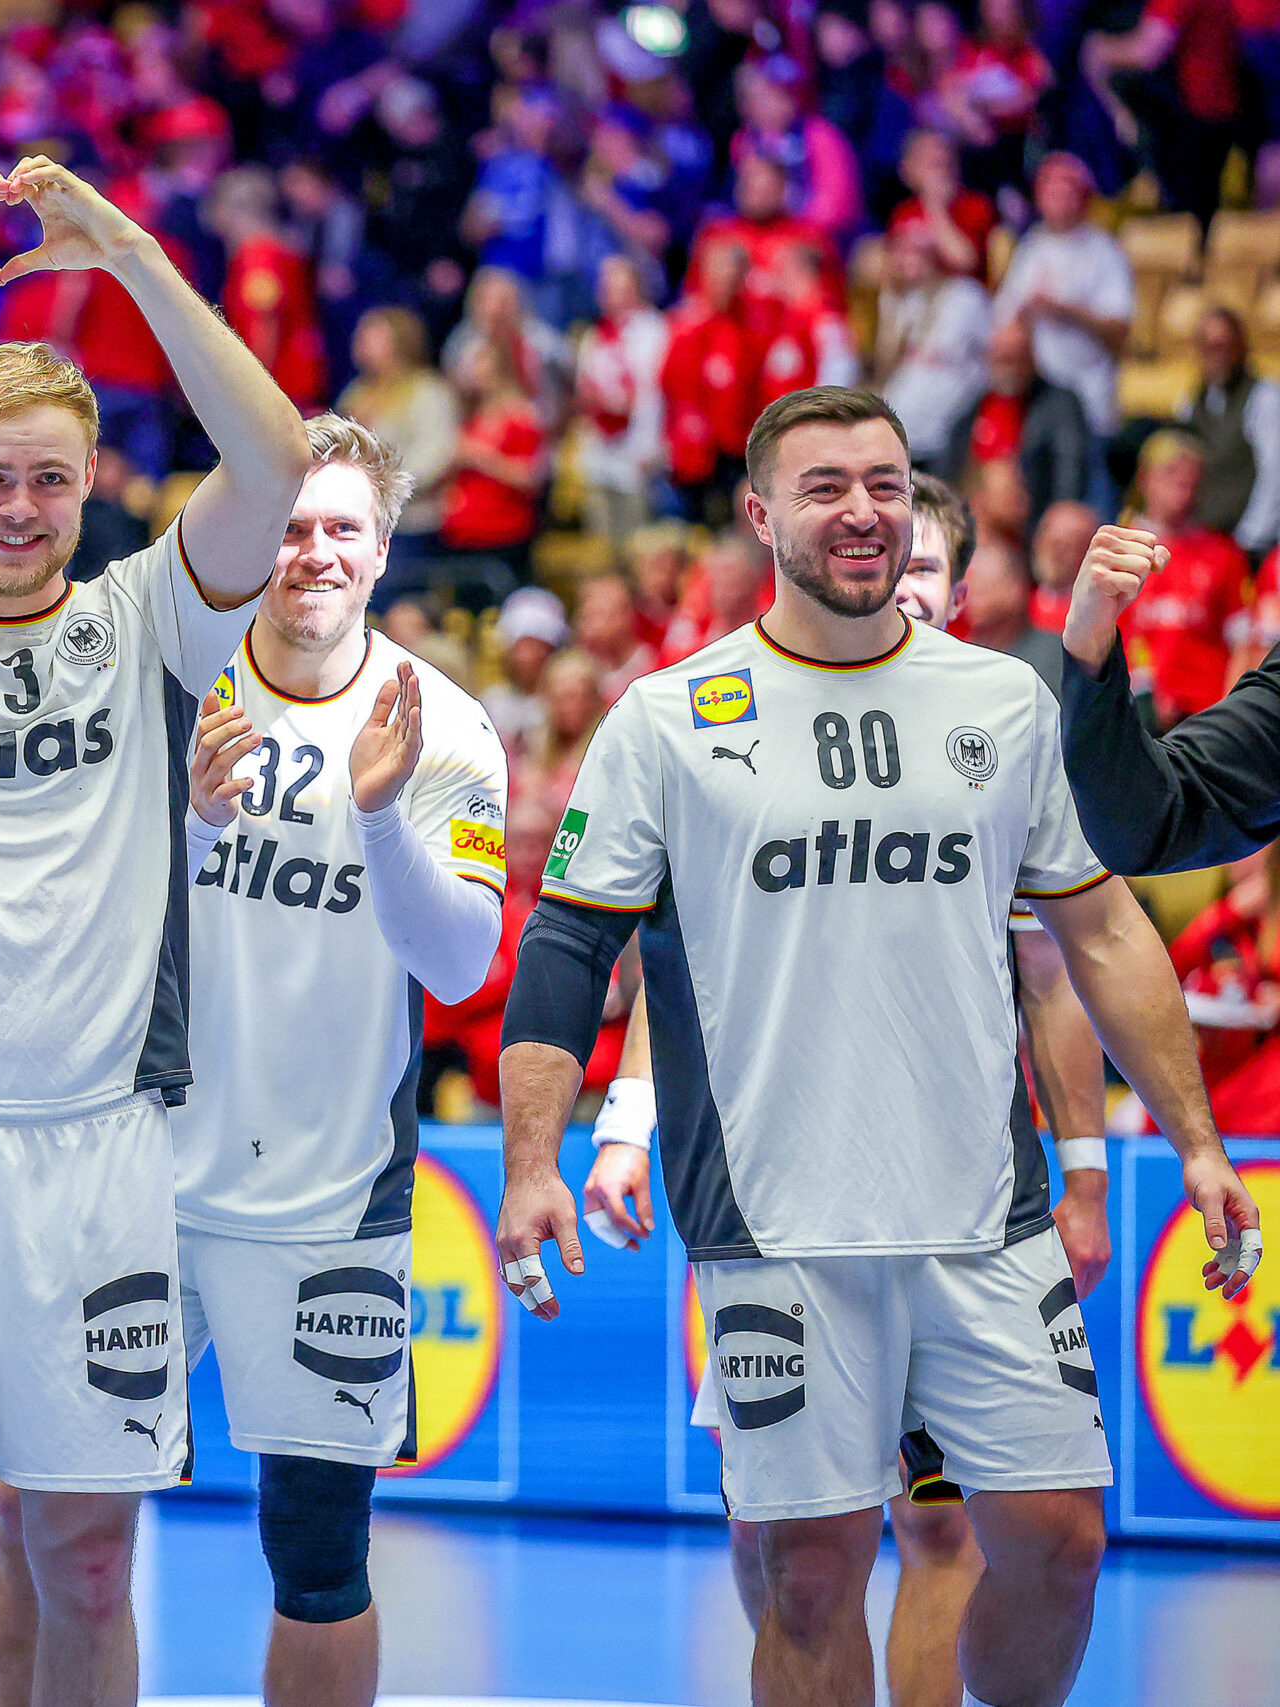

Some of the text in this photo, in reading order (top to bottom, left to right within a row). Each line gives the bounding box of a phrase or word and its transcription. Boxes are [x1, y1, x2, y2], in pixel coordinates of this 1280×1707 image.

[240, 737, 324, 825] 32
[813, 710, 901, 789] 80
[195, 834, 365, 913] atlas
[752, 819, 973, 893] atlas
[85, 1319, 169, 1352] HARTIN
[295, 1311, 405, 1338] HARTING
